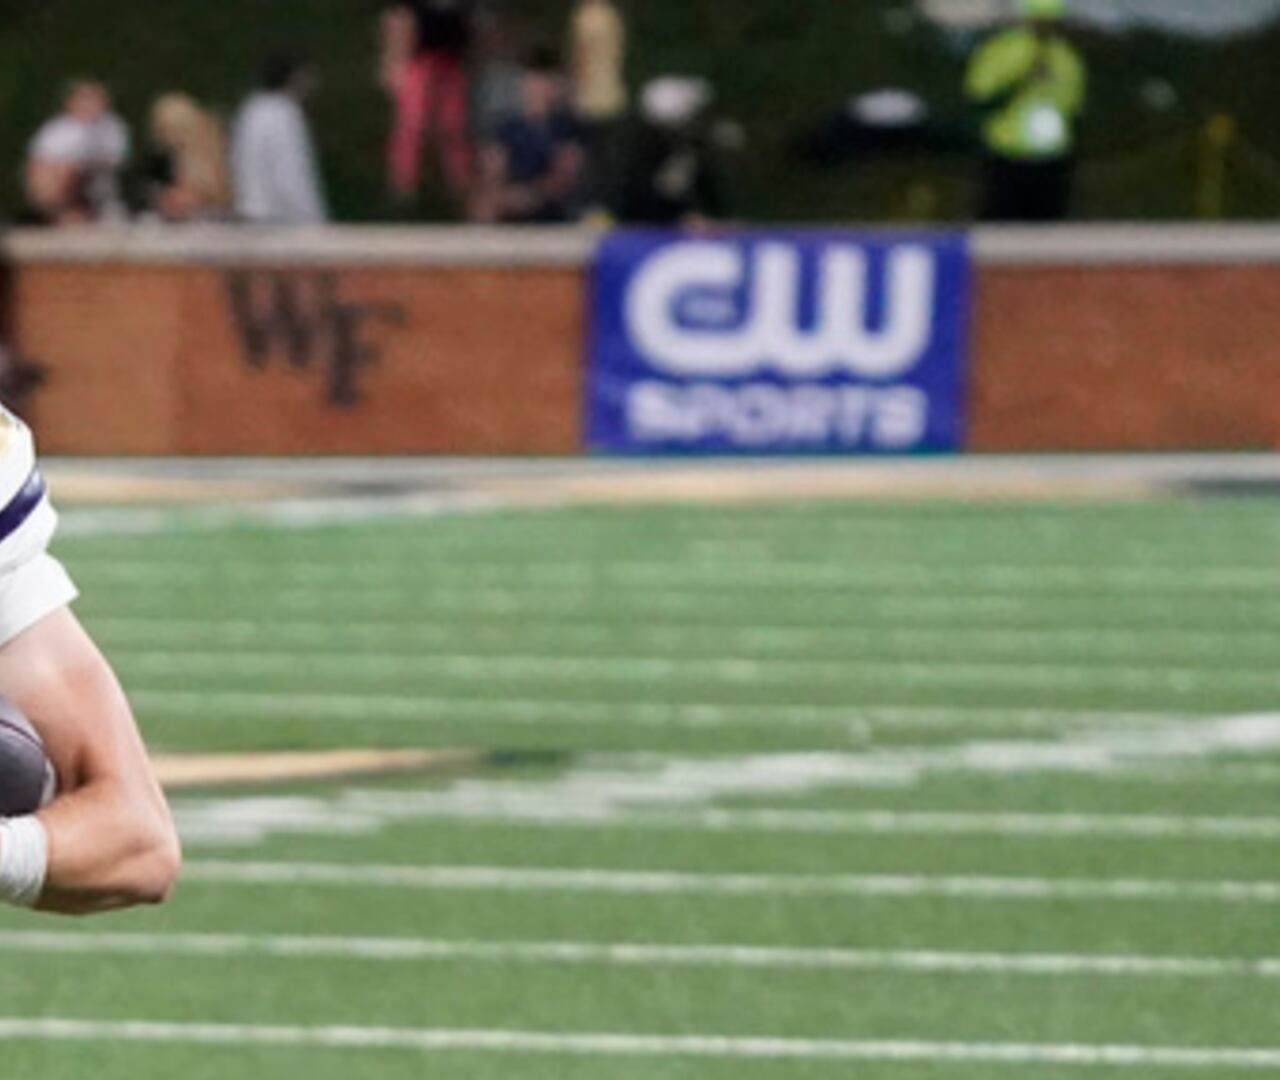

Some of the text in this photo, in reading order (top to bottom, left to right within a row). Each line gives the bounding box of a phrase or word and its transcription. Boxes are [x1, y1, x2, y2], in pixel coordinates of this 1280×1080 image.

[221, 270, 410, 408] WF
[623, 241, 935, 379] CW
[627, 380, 929, 446] SPORTS
